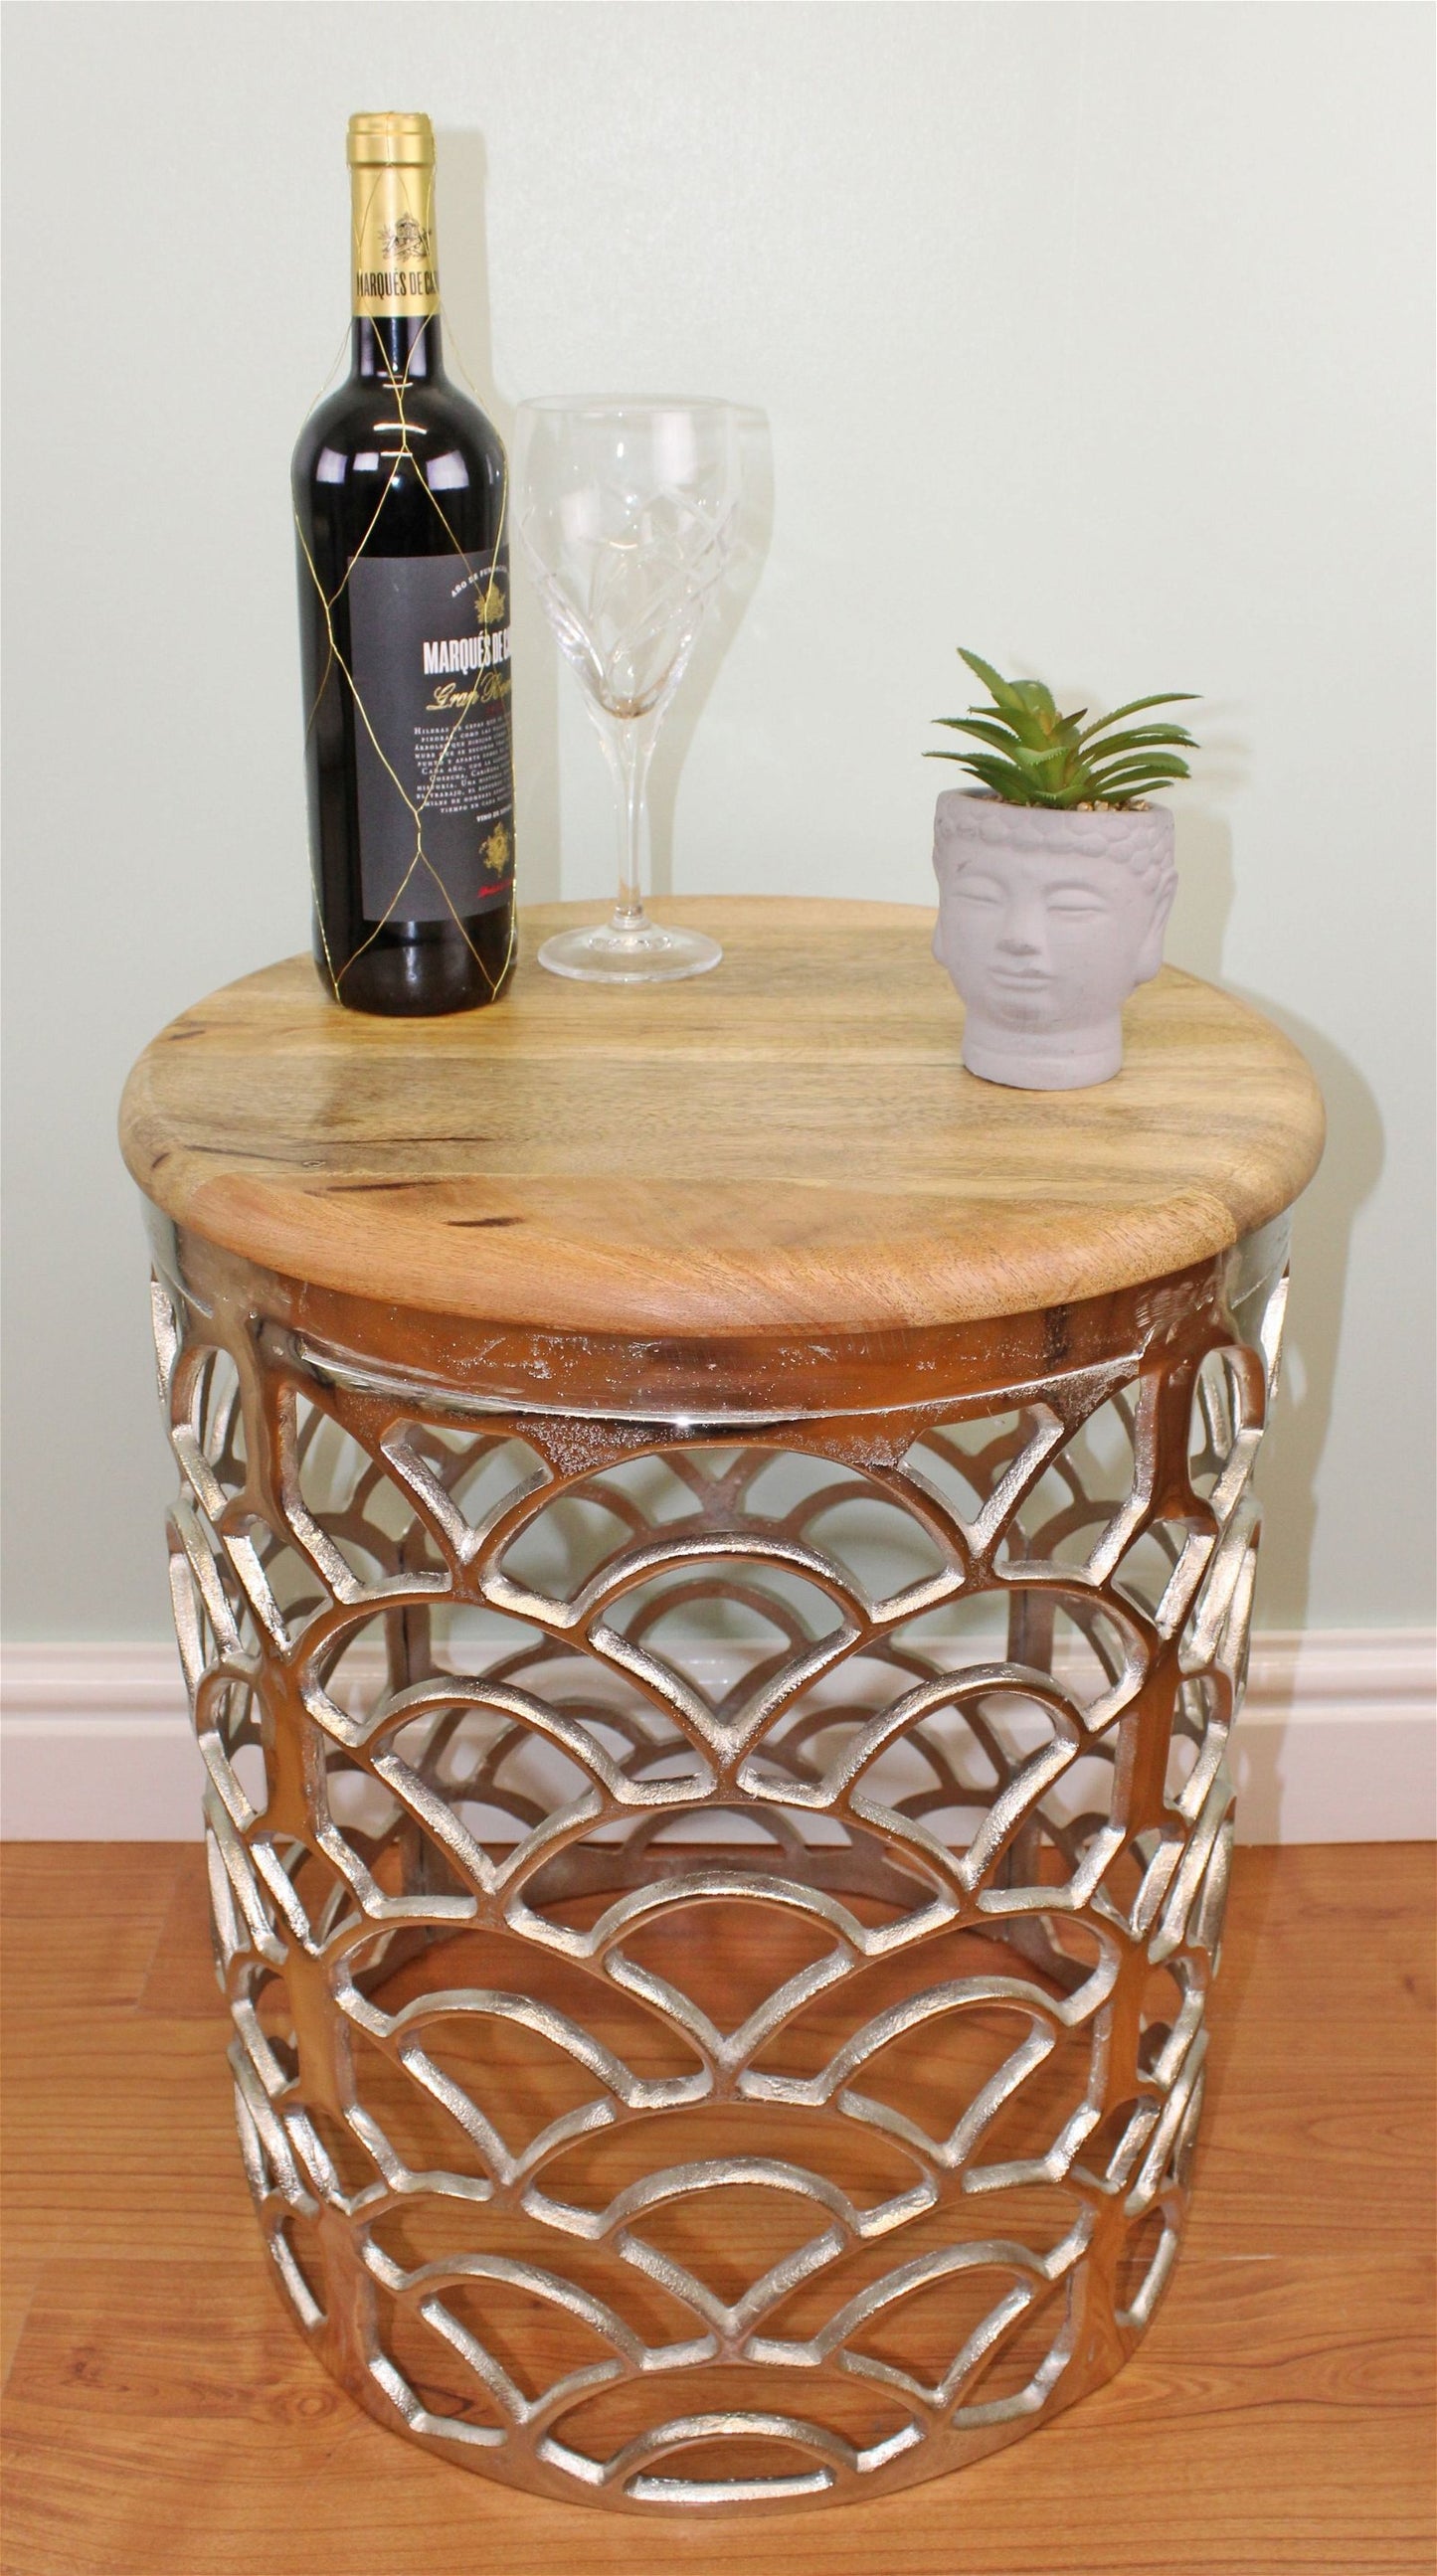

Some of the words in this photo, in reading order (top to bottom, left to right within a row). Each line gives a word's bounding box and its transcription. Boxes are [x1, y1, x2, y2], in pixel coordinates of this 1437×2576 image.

[356, 266, 407, 300] MARQUÉS
[409, 271, 423, 295] DE
[450, 581, 467, 599] AÑO
[423, 630, 491, 676] MARQUÉS
[492, 630, 503, 664] DE
[426, 682, 479, 711] Gran
